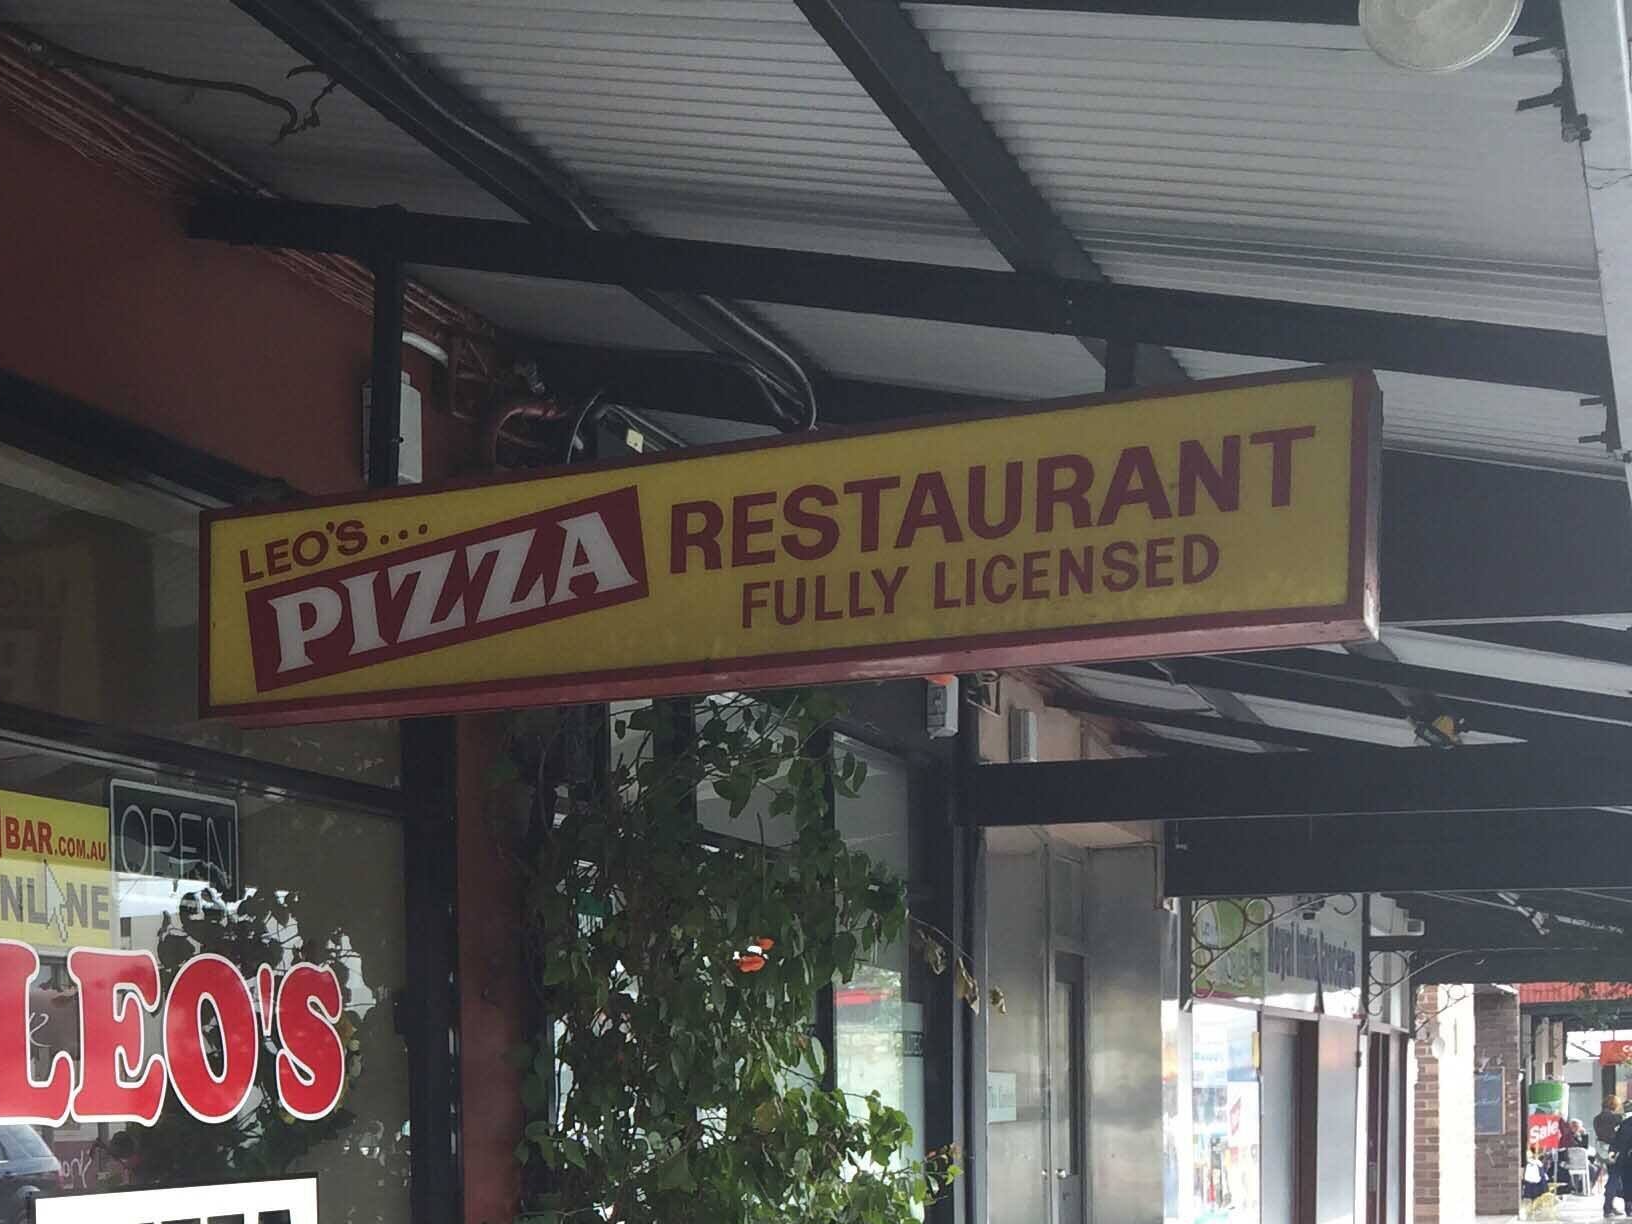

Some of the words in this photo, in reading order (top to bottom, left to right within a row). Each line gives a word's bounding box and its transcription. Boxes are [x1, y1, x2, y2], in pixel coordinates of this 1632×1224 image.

[669, 425, 1317, 574] RESTAURANT
[268, 511, 639, 673] PIZZA
[741, 566, 909, 628] FULLY
[933, 533, 1220, 609] LICENSED
[120, 805, 232, 890] OPEN
[1529, 1119, 1559, 1142] Sale
